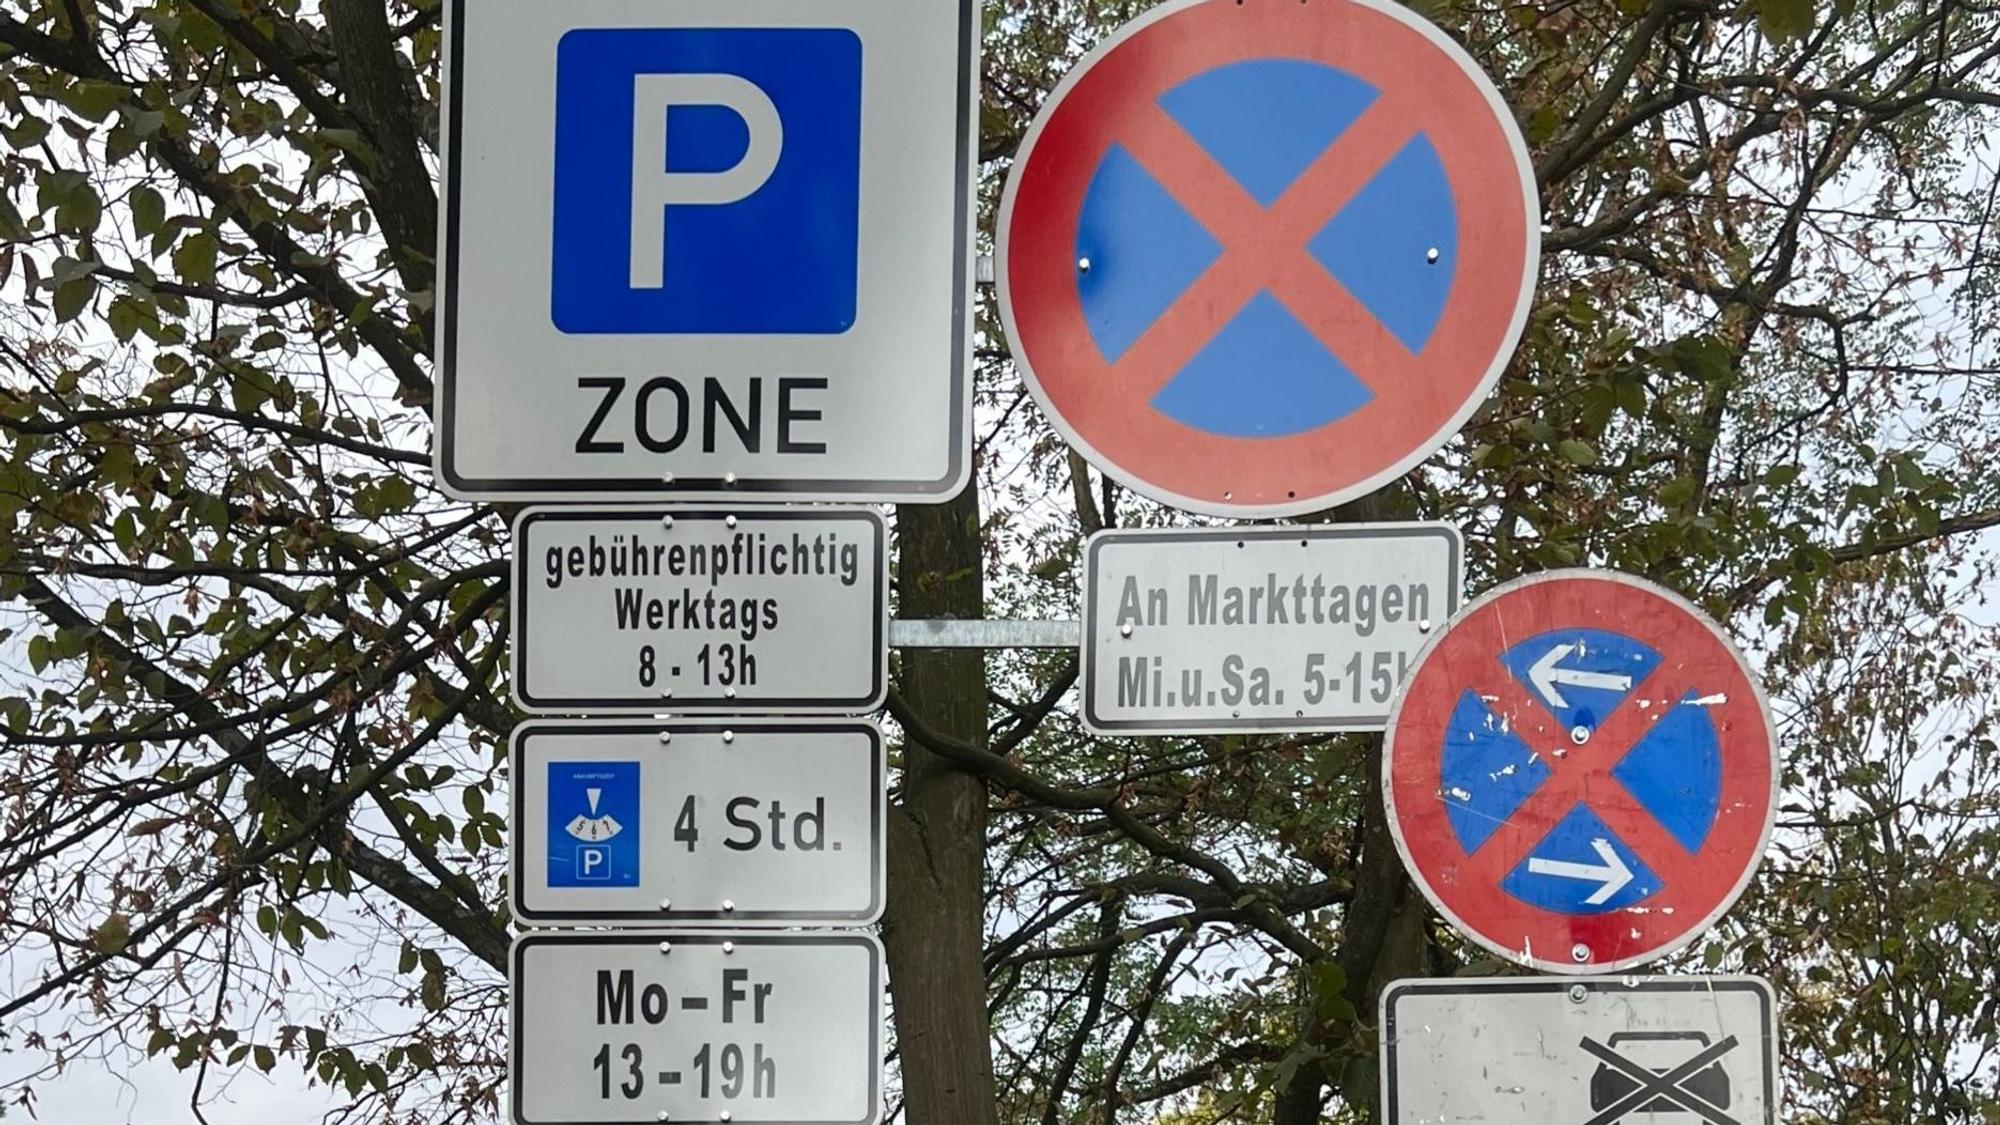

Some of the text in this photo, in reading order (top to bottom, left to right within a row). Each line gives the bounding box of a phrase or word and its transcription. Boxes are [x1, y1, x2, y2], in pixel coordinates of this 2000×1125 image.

[629, 73, 784, 289] P
[575, 376, 829, 454] ZONE
[545, 532, 858, 589] gebührenpflichtig
[614, 587, 779, 641] Werktags
[1116, 572, 1429, 637] An Markttagen
[673, 794, 842, 853] 4 Std.
[584, 849, 603, 875] P
